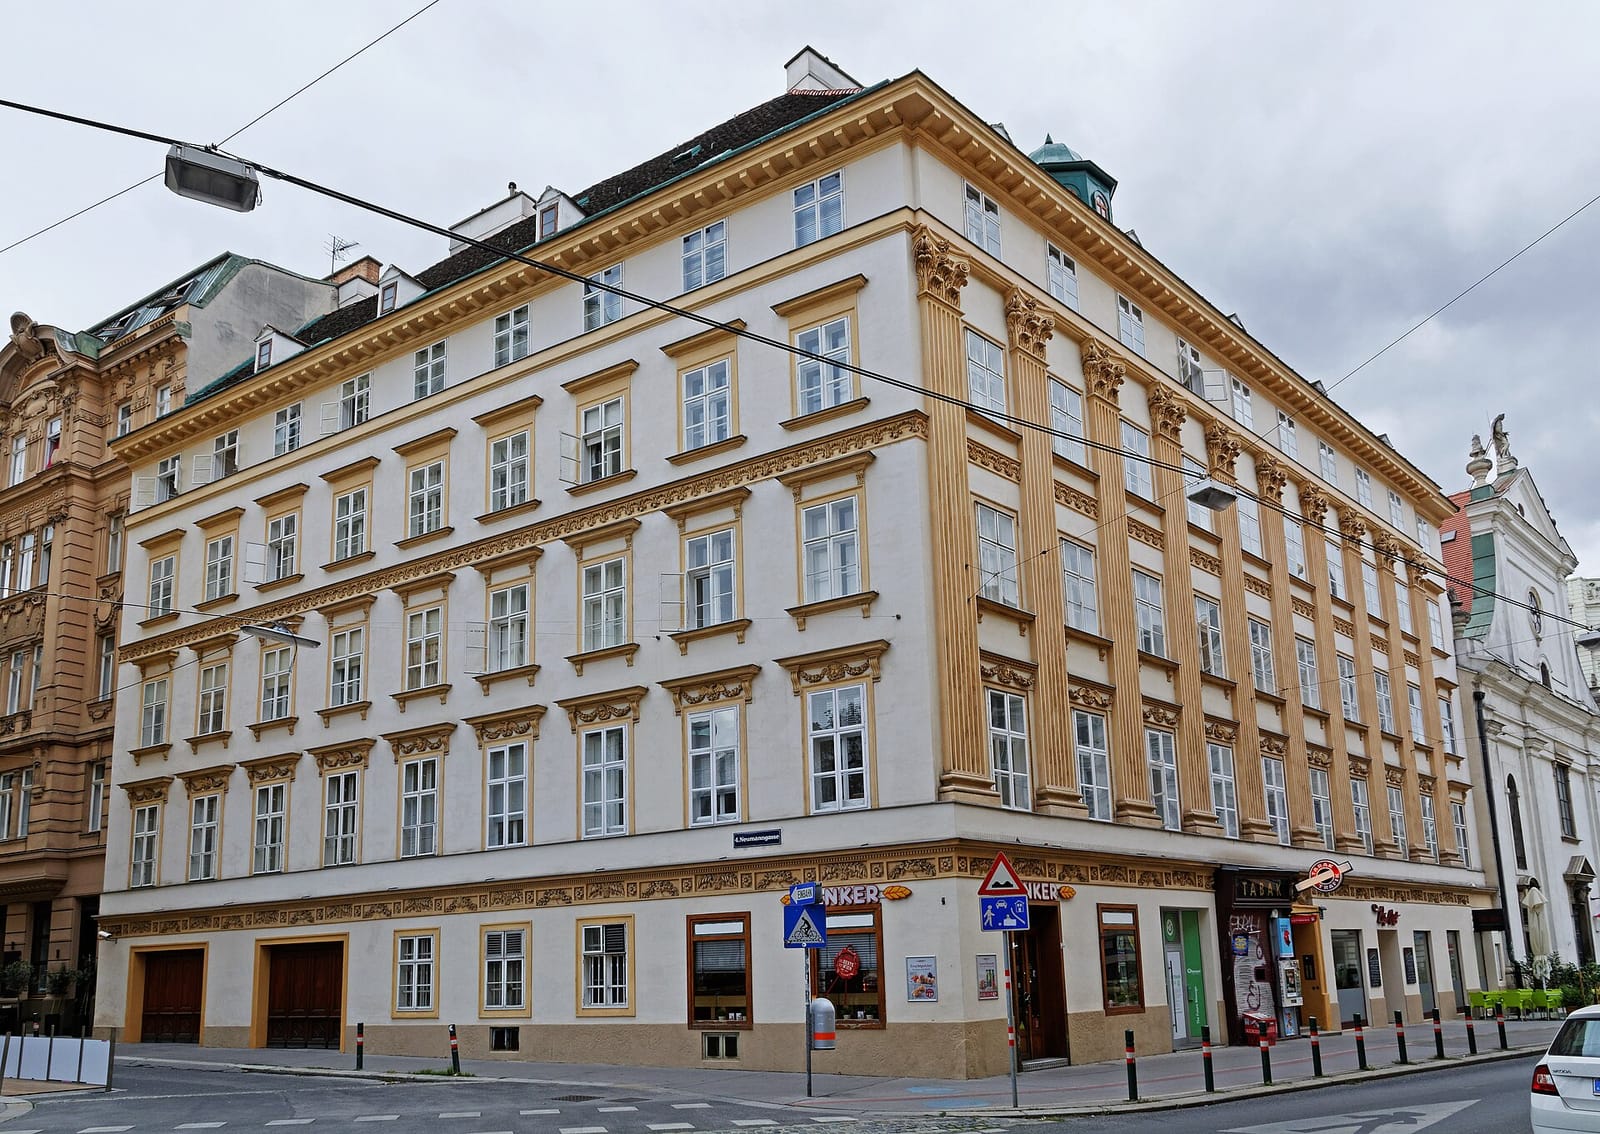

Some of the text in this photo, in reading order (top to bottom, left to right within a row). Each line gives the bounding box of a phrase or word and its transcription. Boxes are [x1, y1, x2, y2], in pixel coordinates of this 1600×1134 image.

[1311, 862, 1334, 878] TABAK
[797, 888, 812, 899] EINBAHN
[820, 885, 880, 905] NKER
[1023, 882, 1058, 901] NKER
[1242, 881, 1282, 897] TABAK
